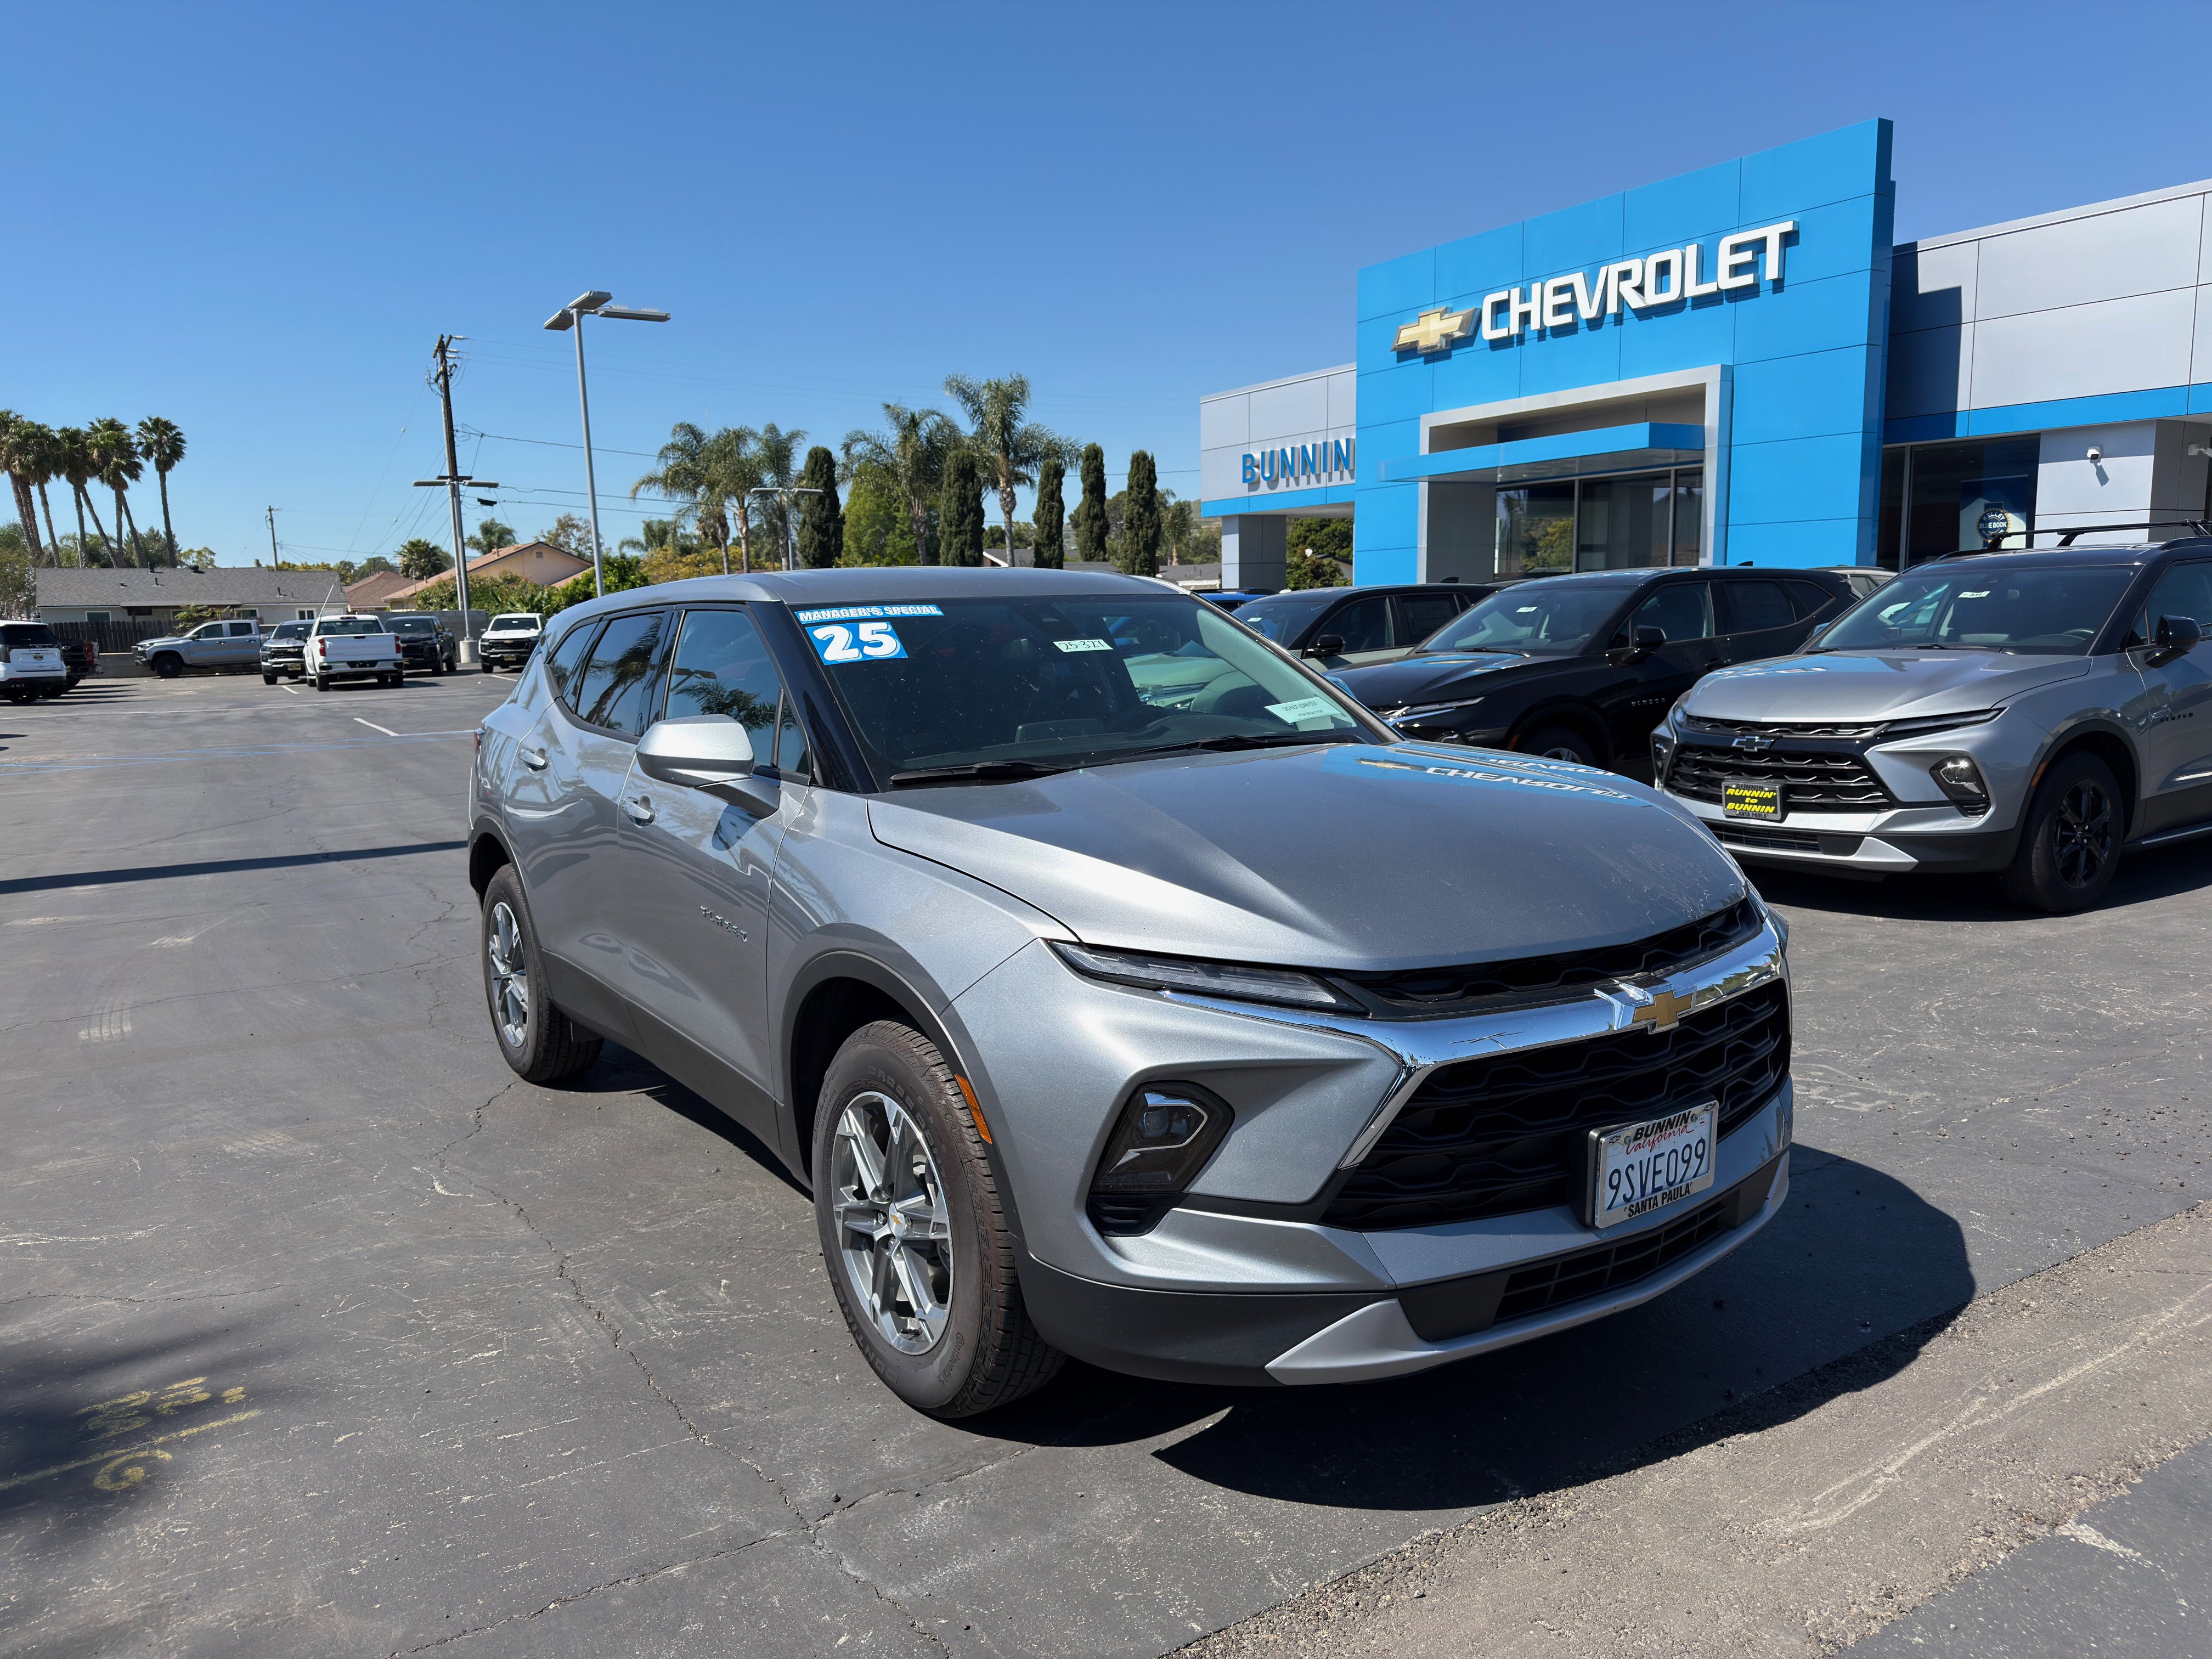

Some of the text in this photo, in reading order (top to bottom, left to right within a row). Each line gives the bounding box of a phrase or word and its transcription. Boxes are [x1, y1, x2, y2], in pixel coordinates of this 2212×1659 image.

[1482, 220, 1796, 340] CHEVROLET
[1242, 438, 1354, 483] BUNNIN
[1983, 511, 2006, 521] KELLEY
[799, 606, 942, 622] MANAGER'S SPECIAL
[812, 623, 901, 662] 25
[1726, 788, 1777, 798] RUNNIN'
[1726, 803, 1775, 813] BUNNIN
[1626, 1124, 1694, 1155] California
[1633, 1110, 1691, 1142] BUNNIN
[1606, 1137, 1706, 1210] 9SVE099
[1628, 1186, 1691, 1217] SANTA PAULA
